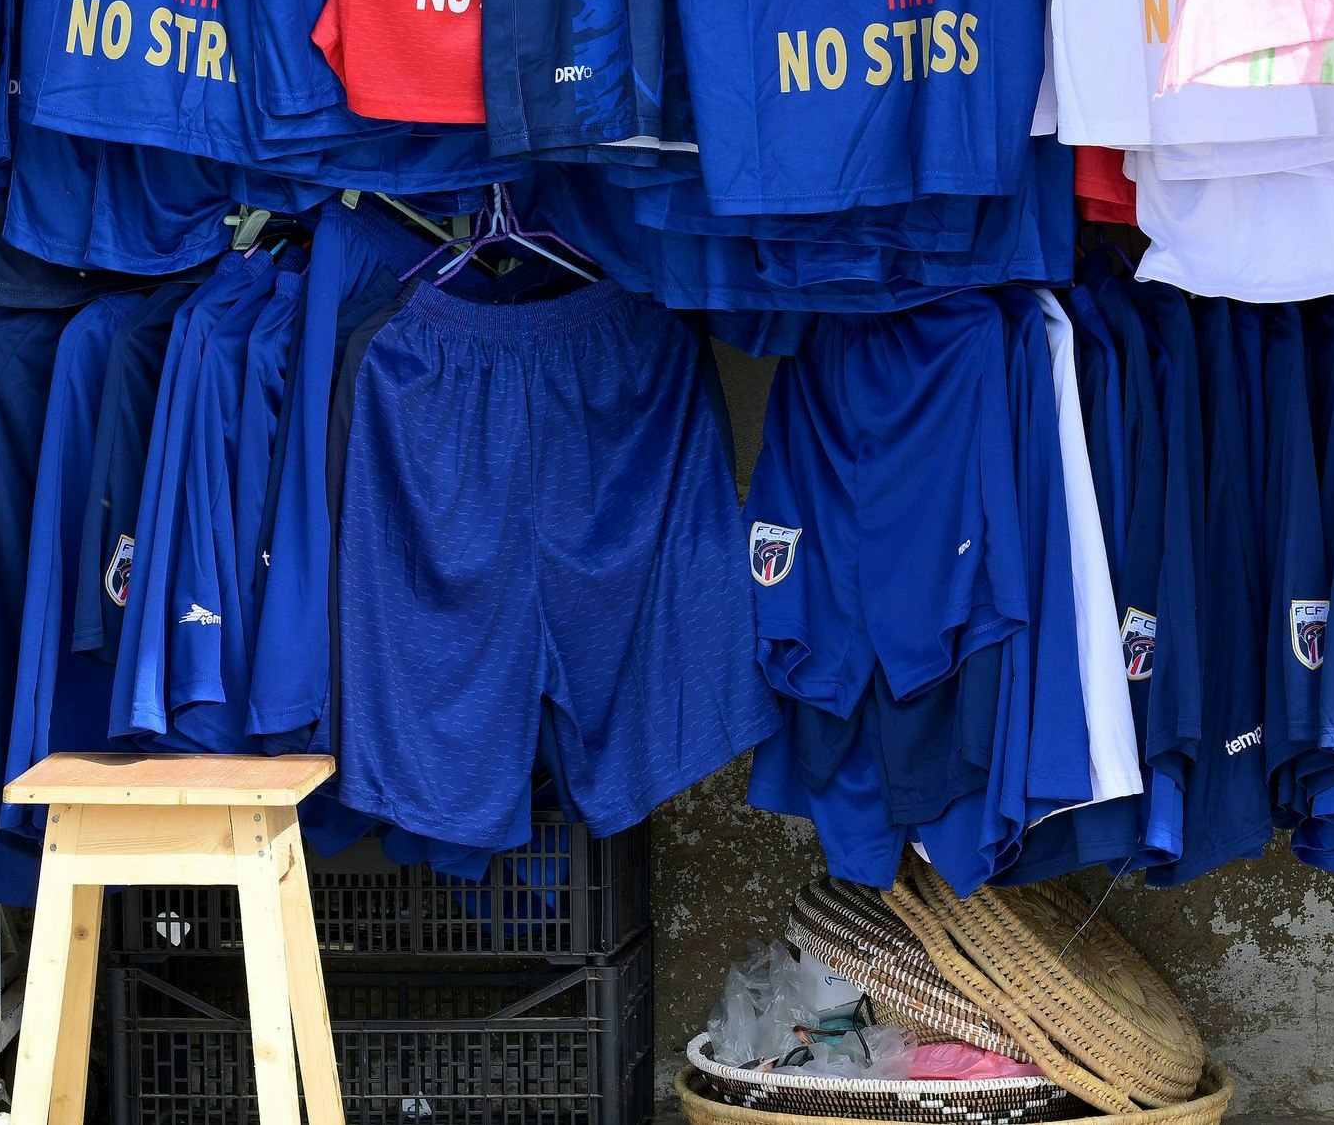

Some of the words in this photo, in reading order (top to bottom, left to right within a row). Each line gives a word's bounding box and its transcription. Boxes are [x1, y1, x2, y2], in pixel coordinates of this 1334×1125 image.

[150, 14, 237, 83] STR
[777, 27, 848, 94] NO
[555, 65, 585, 83] DRY
[757, 526, 794, 536] FCF
[1295, 606, 1326, 616] FCF
[1130, 616, 1155, 630] FC
[1225, 727, 1263, 755] temp
